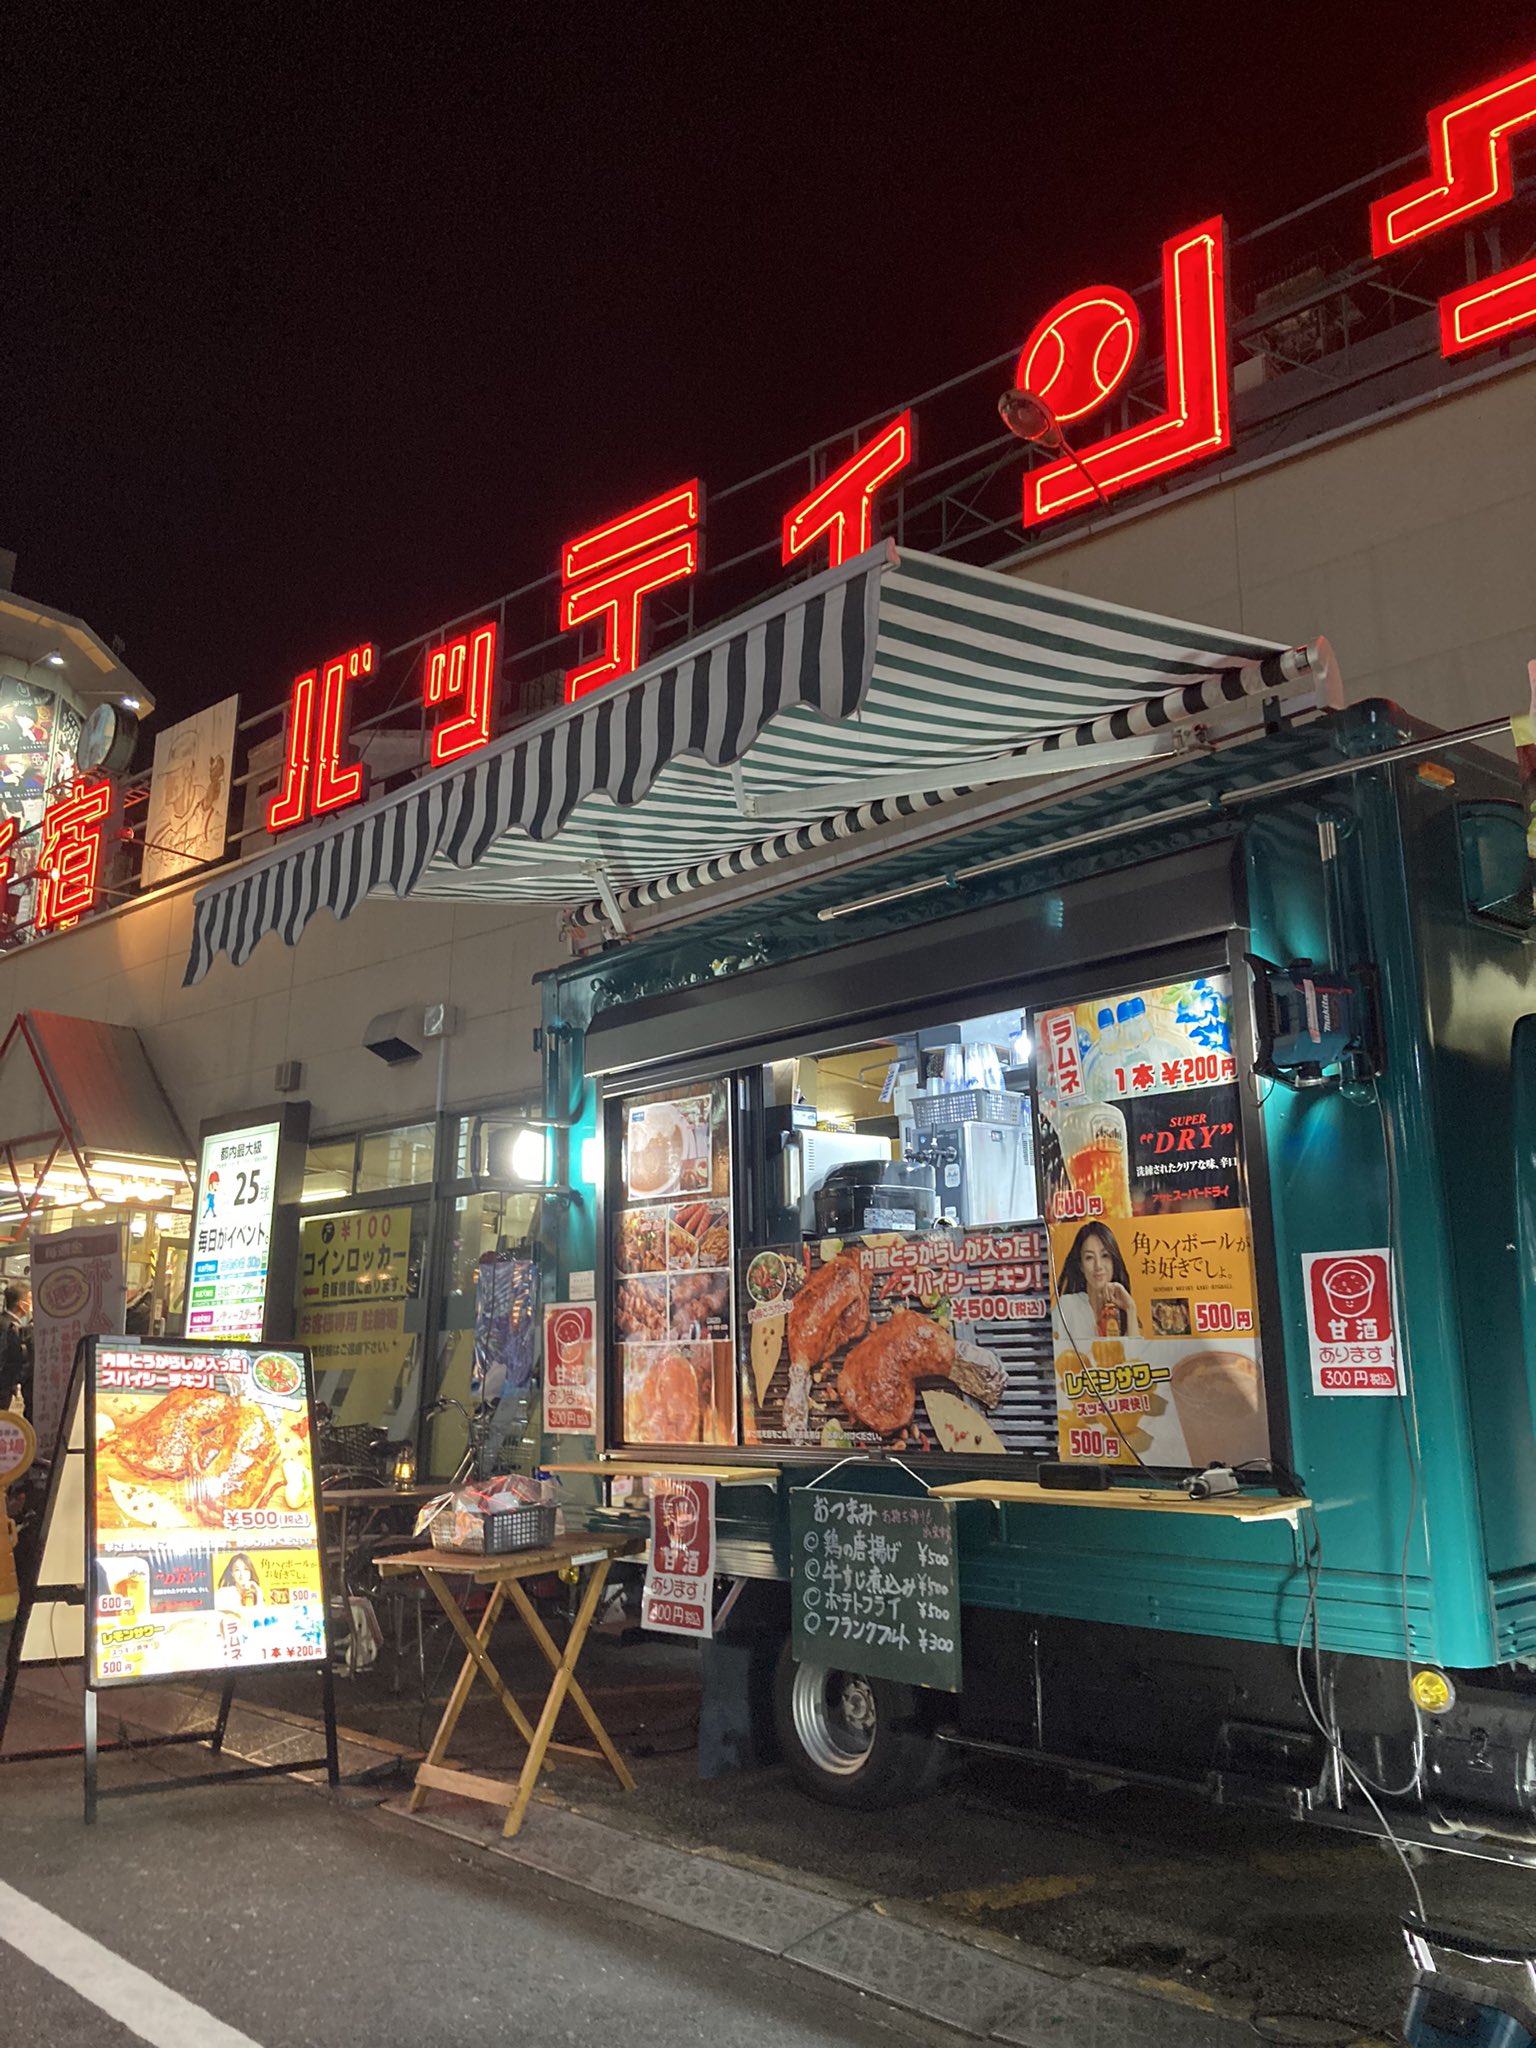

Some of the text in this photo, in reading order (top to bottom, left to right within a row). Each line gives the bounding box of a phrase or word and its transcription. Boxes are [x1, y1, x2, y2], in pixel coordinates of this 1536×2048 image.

[1322, 992, 1332, 1033] makita
[1052, 1018, 1081, 1095] ラムネ
[1169, 1113, 1208, 1129] SUPER
[220, 1141, 262, 1161] 都内最大級
[234, 1168, 261, 1206] 25
[303, 1243, 406, 1277] コインロッカー
[1132, 1230, 1251, 1258] 角ハイボールが
[1141, 1256, 1233, 1280] お好きでしょ。
[1195, 1303, 1252, 1331] 500円
[1327, 1318, 1378, 1341] 甘酒
[1065, 1363, 1171, 1397] レモンサワー
[1070, 1429, 1119, 1456] 500円
[813, 1494, 878, 1527] おつまみ
[661, 1547, 700, 1574] 甘酒
[823, 1528, 949, 1567] 鶏の唐揚げ ¥500
[822, 1560, 949, 1598] 牛すじ煮込み ¥500
[825, 1588, 950, 1621] ポテトフライ ¥500
[226, 1622, 243, 1661] ラムネ
[825, 1616, 954, 1654] フランクフルト ¥300
[102, 1661, 132, 1674] 500円
